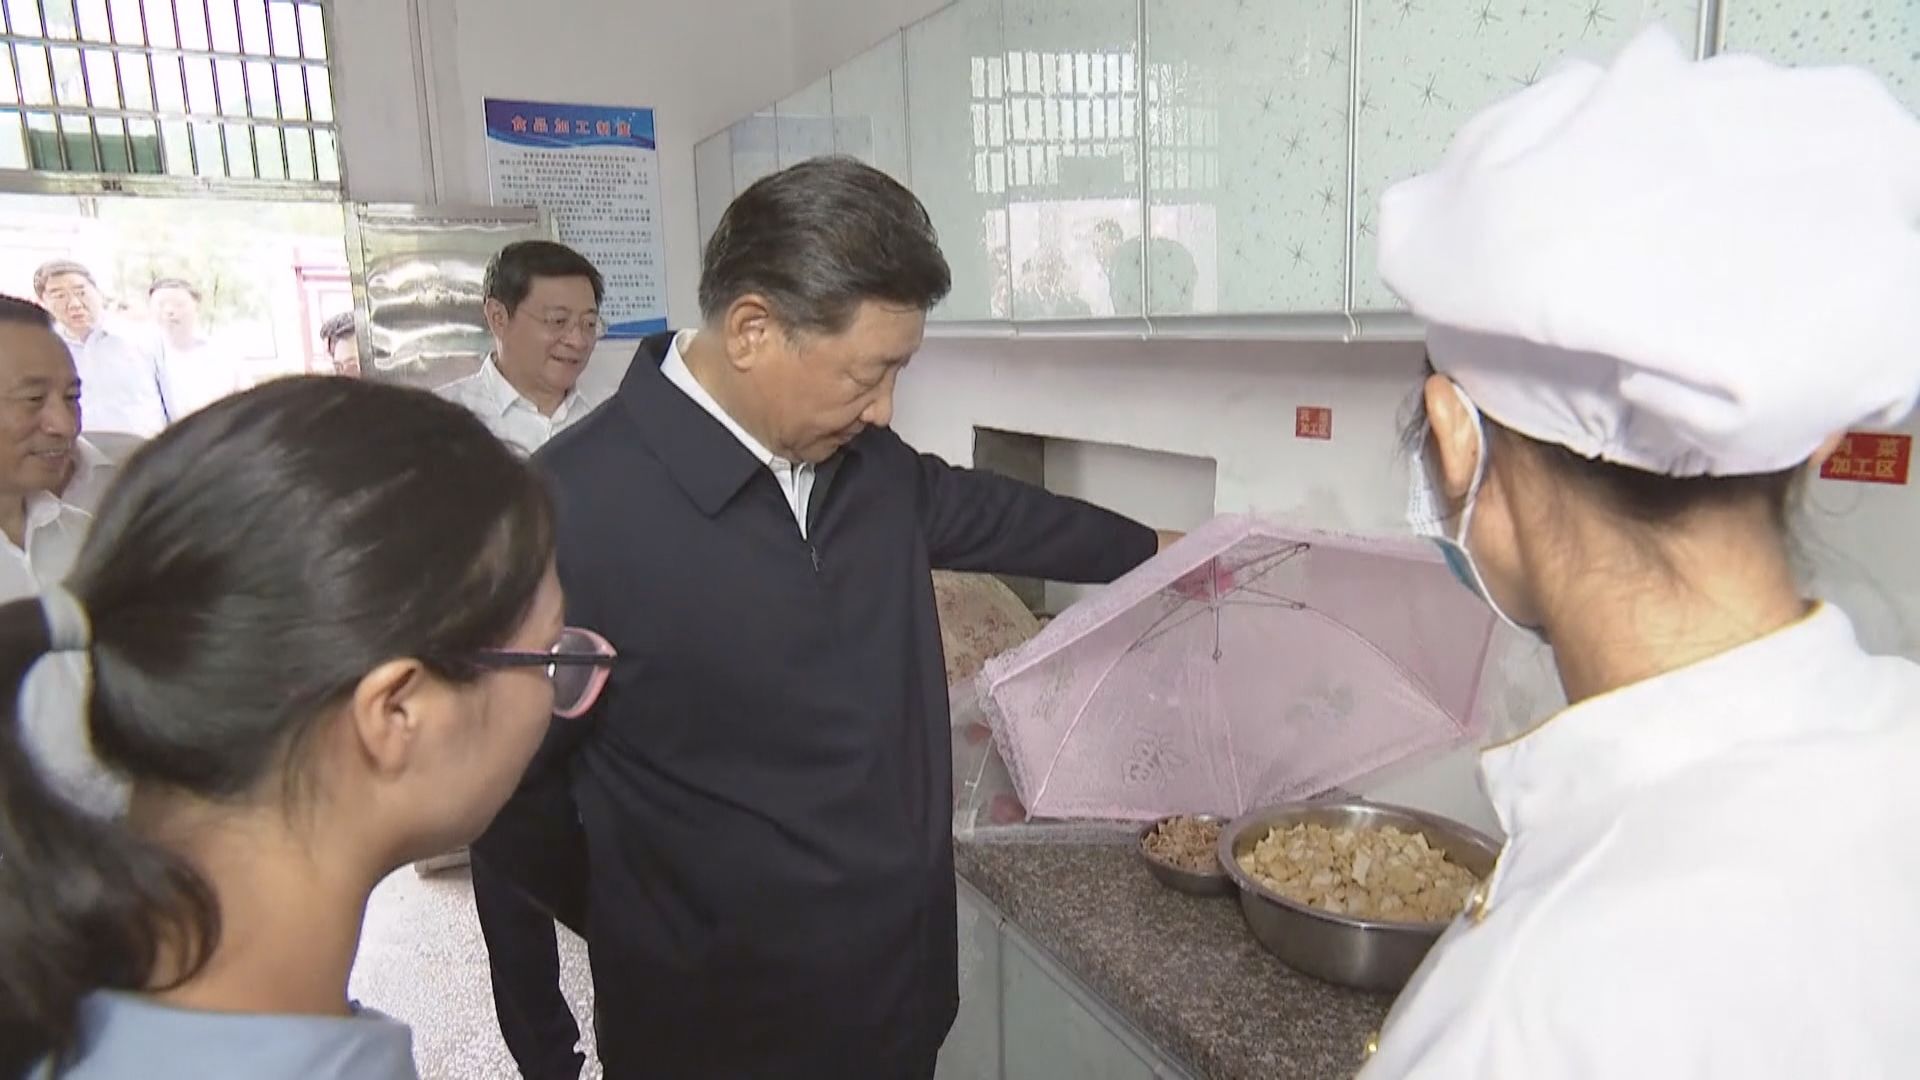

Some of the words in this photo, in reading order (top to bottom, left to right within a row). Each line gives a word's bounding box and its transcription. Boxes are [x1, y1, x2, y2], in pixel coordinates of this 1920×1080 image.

[512, 115, 631, 138] 食品加工制度
[1830, 457, 1897, 478] 加工区
